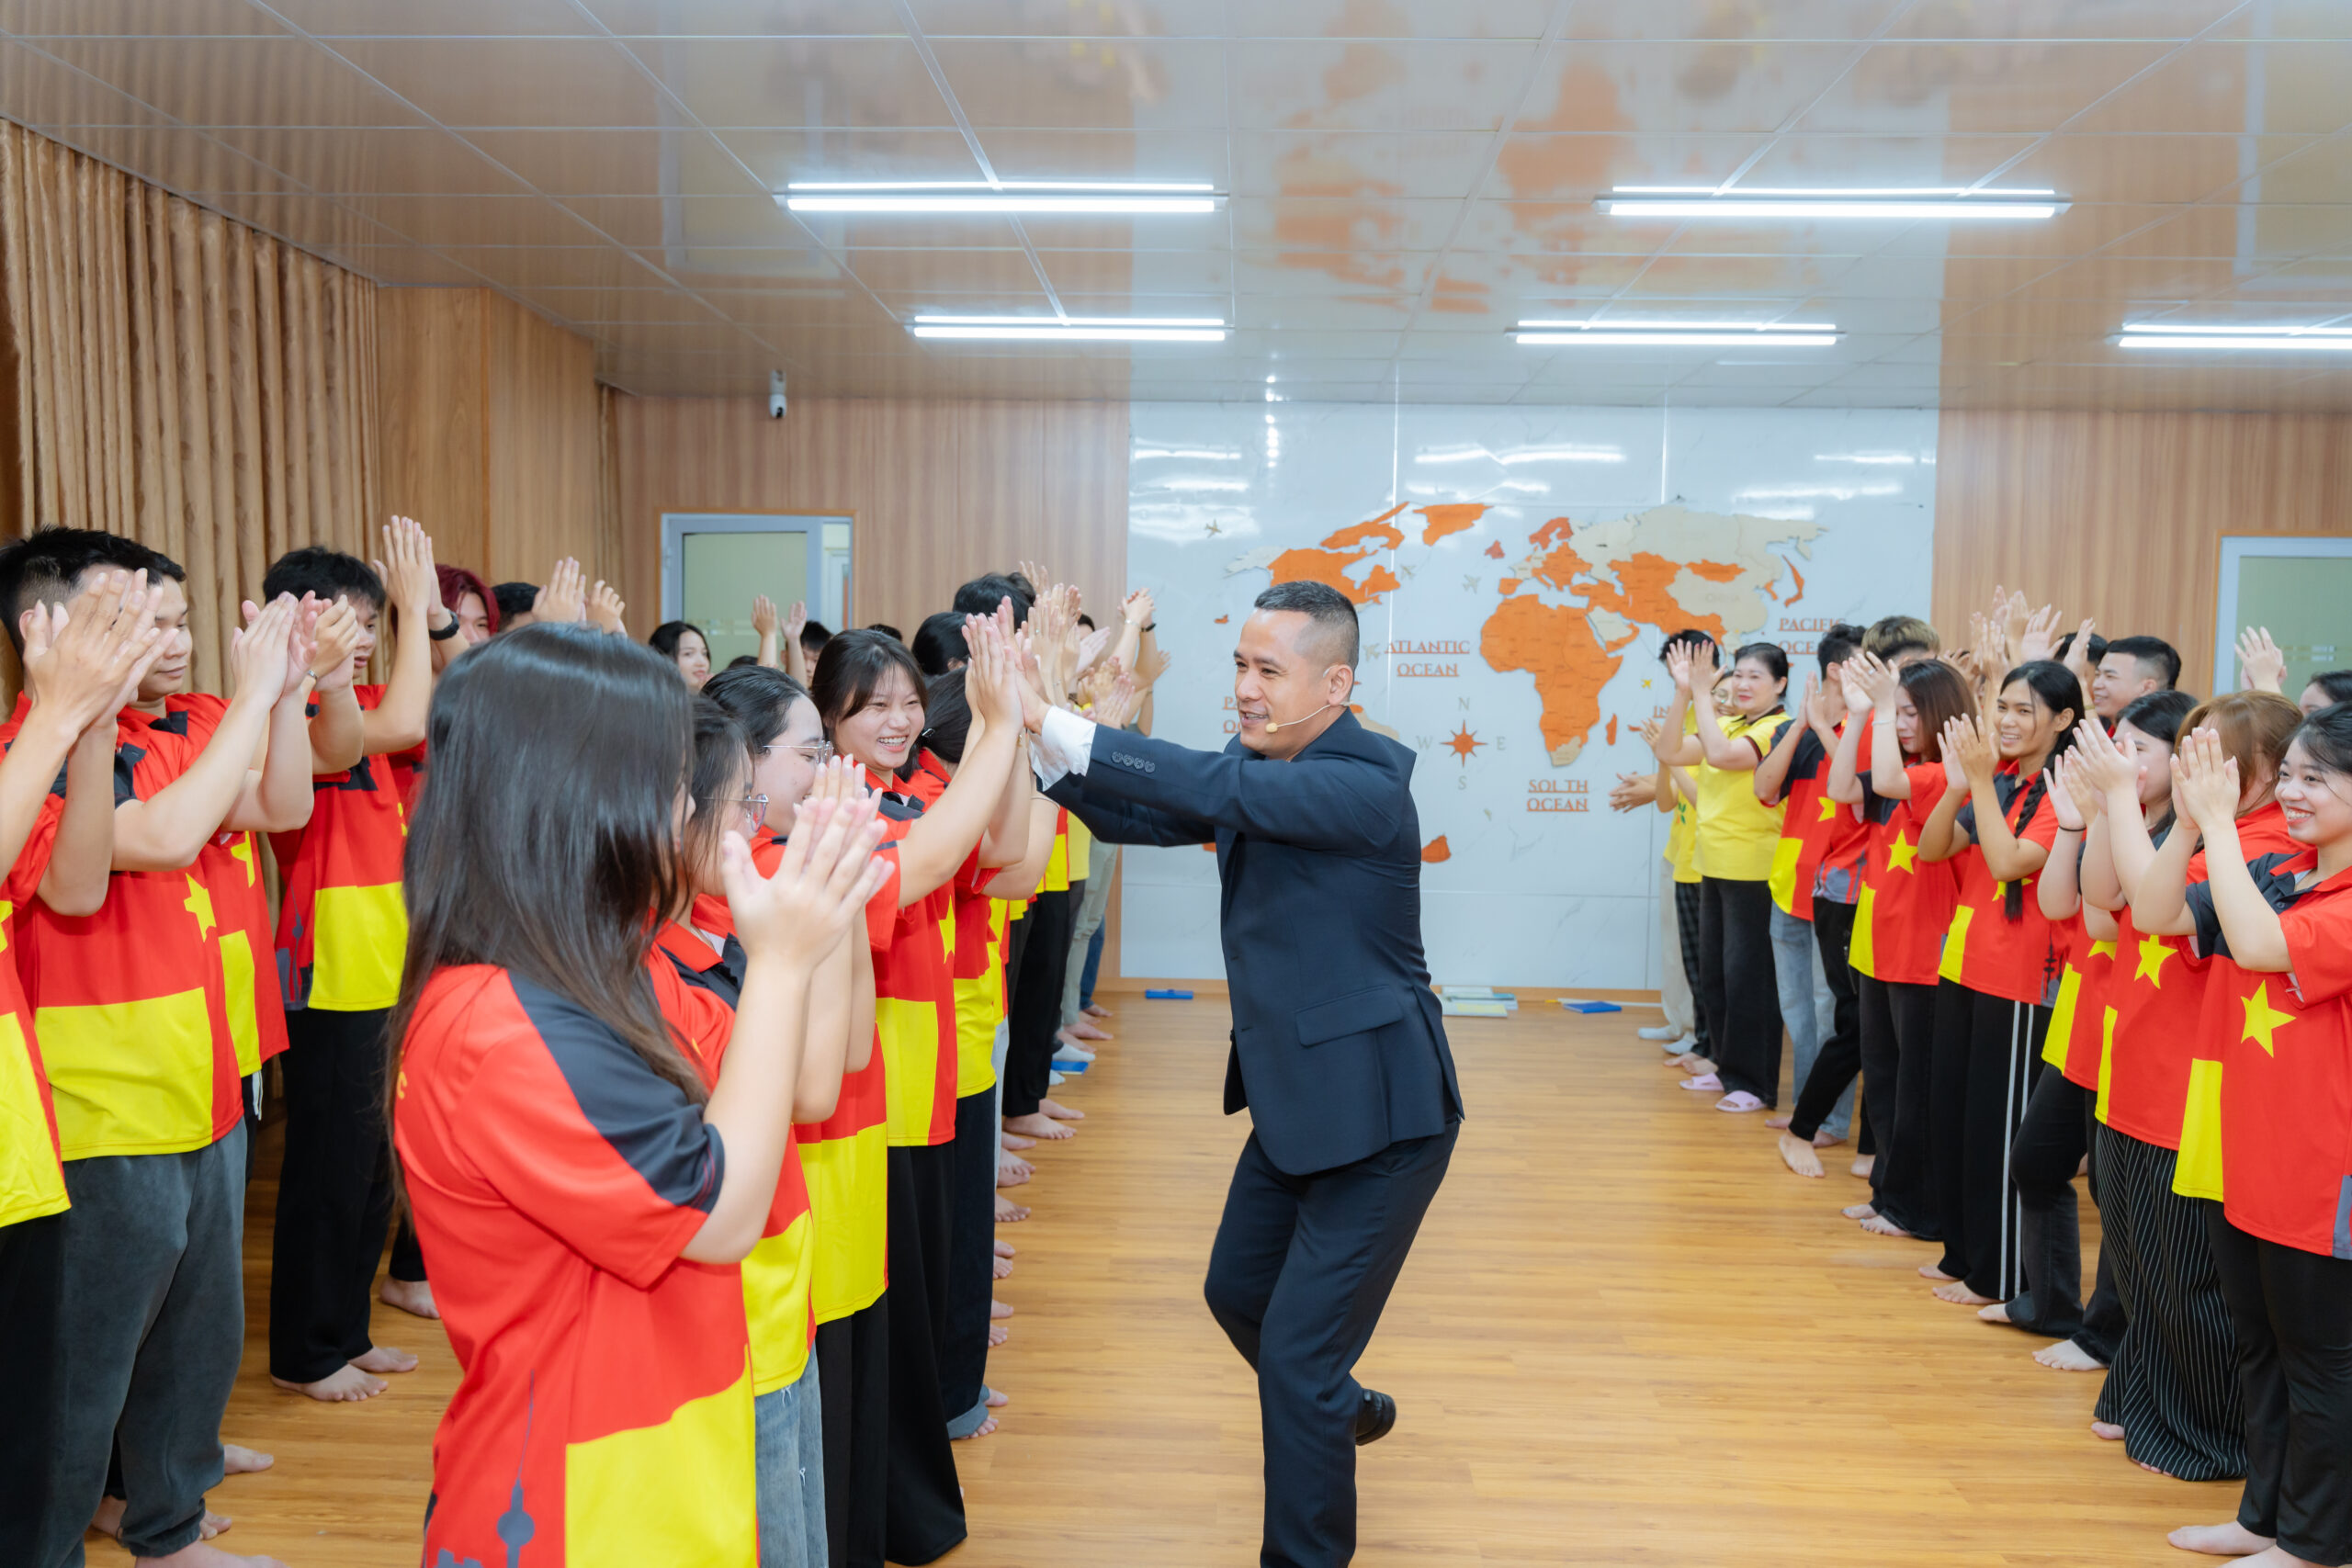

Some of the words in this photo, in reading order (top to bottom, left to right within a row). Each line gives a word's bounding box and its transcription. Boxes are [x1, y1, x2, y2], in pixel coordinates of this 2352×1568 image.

[1385, 640, 1470, 654] ATLANTIC
[1779, 639, 1819, 655] OCE
[1396, 662, 1459, 677] OCEAN
[1457, 696, 1471, 712] N
[1416, 735, 1433, 750] W
[1496, 736, 1507, 750] E
[1457, 774, 1467, 791] S
[1526, 797, 1589, 812] OCEAN
